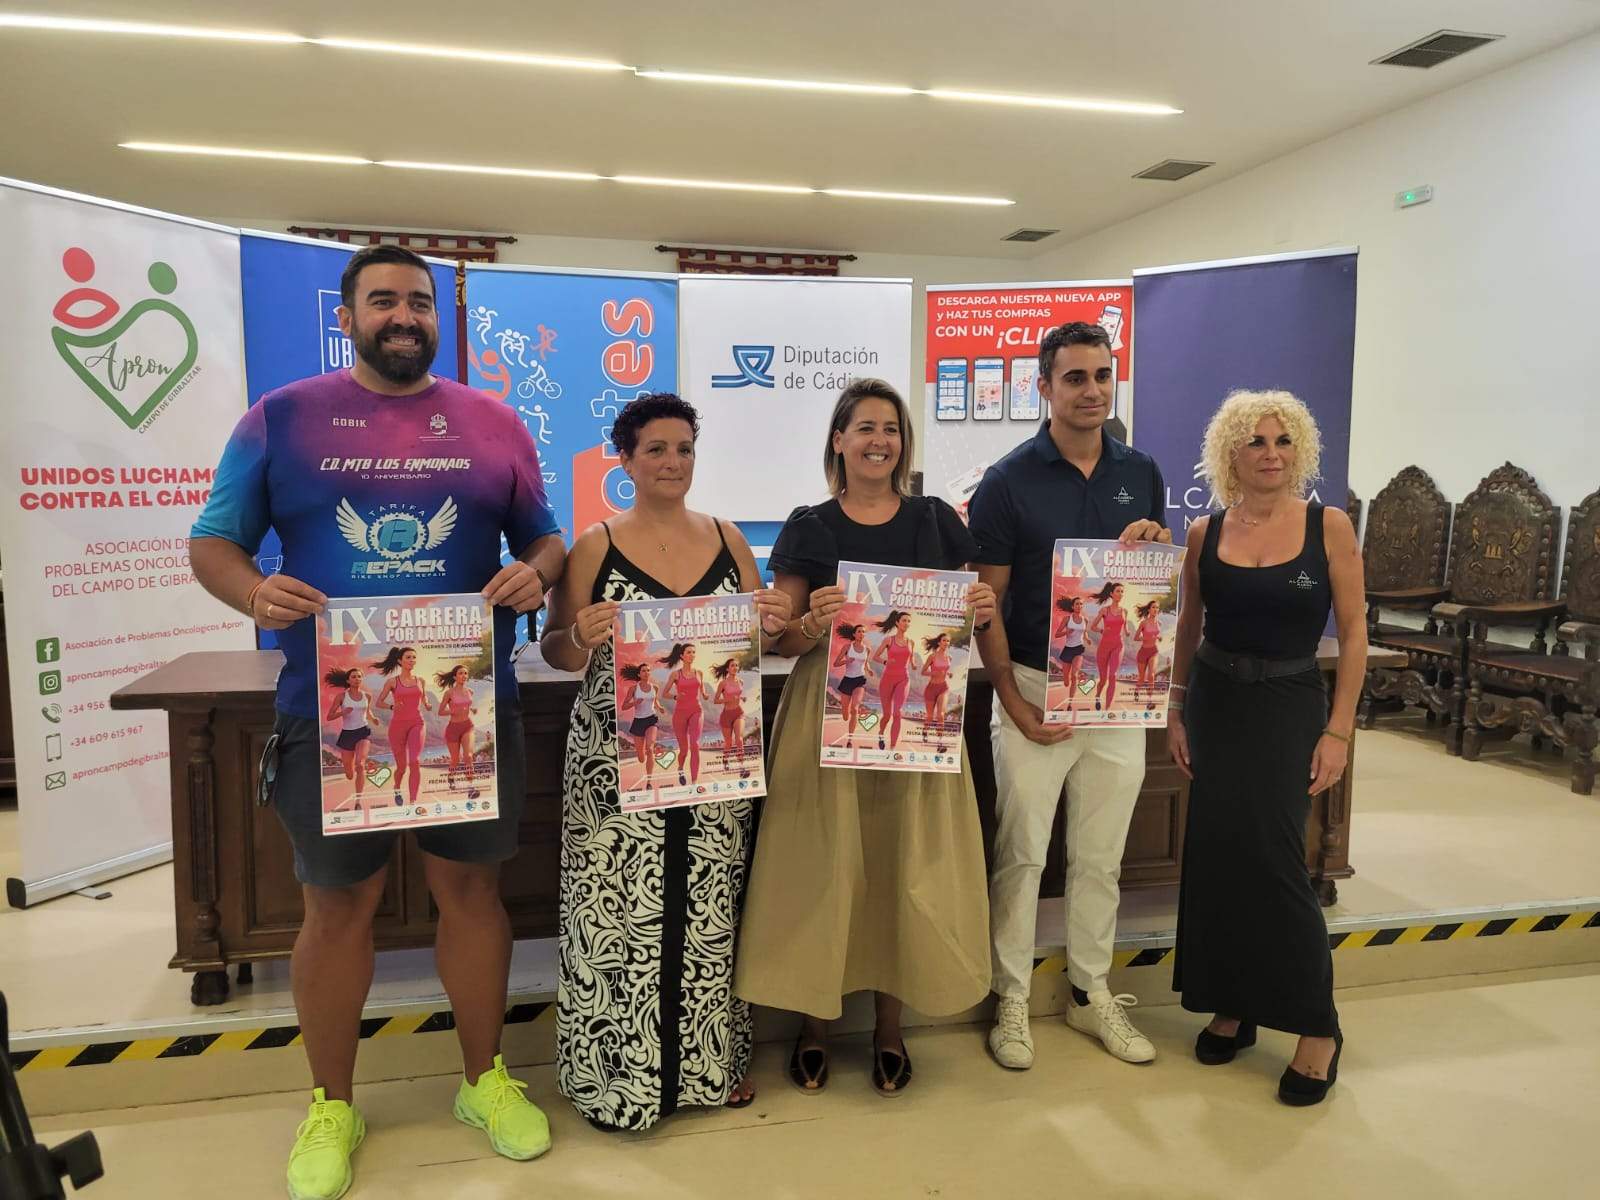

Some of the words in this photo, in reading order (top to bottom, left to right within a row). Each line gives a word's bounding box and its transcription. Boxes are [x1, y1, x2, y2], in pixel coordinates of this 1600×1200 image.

[938, 295, 997, 306] DESCARGA
[1000, 294, 1052, 305] NUESTRA
[1055, 293, 1095, 303] NUEVA
[1097, 292, 1122, 302] APP
[936, 311, 944, 322] y
[946, 310, 969, 320] HAZ
[971, 310, 993, 319] TUS
[995, 308, 1051, 318] COMPRAS
[935, 325, 969, 338] CON
[972, 325, 994, 337] UN
[328, 336, 358, 369] UB
[783, 345, 879, 367] Diputación
[84, 341, 174, 392] Apron
[783, 371, 805, 390] de
[813, 371, 852, 390] Cádi
[139, 409, 160, 434] CAMPO
[159, 399, 170, 411] DE
[167, 365, 202, 402] GIBRALTAR
[332, 417, 368, 428] GOBIK
[375, 457, 401, 471] LOS
[403, 457, 472, 472] ENMONAOS
[20, 466, 115, 486] UNIDOS
[119, 466, 218, 484] LUCHAM
[19, 490, 124, 511] CONTRA
[128, 489, 153, 508] EL
[368, 503, 425, 517] TARIFA
[85, 537, 172, 556] ASOCIACIÓN
[44, 560, 131, 578] PROBLEMAS
[350, 559, 447, 574] REPACK
[1061, 546, 1100, 578] IX
[1103, 549, 1174, 568] CARRERA
[1103, 566, 1125, 580] POR
[1125, 566, 1138, 579] LA
[1140, 566, 1172, 579] MUJER
[52, 583, 78, 598] DEL
[82, 577, 134, 594] CAMPO
[138, 575, 155, 589] DE
[159, 573, 199, 587] GIBRA
[846, 570, 888, 606] IX
[890, 576, 969, 600] CARRERA
[889, 593, 913, 608] POR
[915, 596, 928, 608] LA
[328, 606, 382, 646] IX
[384, 605, 483, 628] CARRERA
[385, 627, 415, 643] POR
[417, 625, 435, 641] LA
[437, 623, 482, 641] MUJER
[622, 607, 668, 644] IX
[669, 604, 752, 627] CARRERA
[670, 625, 695, 641] POR
[696, 623, 711, 638] LA
[712, 621, 751, 636] MUJER
[65, 636, 113, 651] Asociación
[115, 635, 126, 644] de
[127, 629, 172, 642] Problemas
[221, 620, 244, 632] Apron
[66, 660, 167, 684] aproncampodegibralt
[87, 701, 105, 711] 956
[89, 732, 109, 744] 609
[111, 728, 126, 739] 615
[127, 725, 144, 735] 967
[72, 751, 171, 781] aproncampodegibralta
